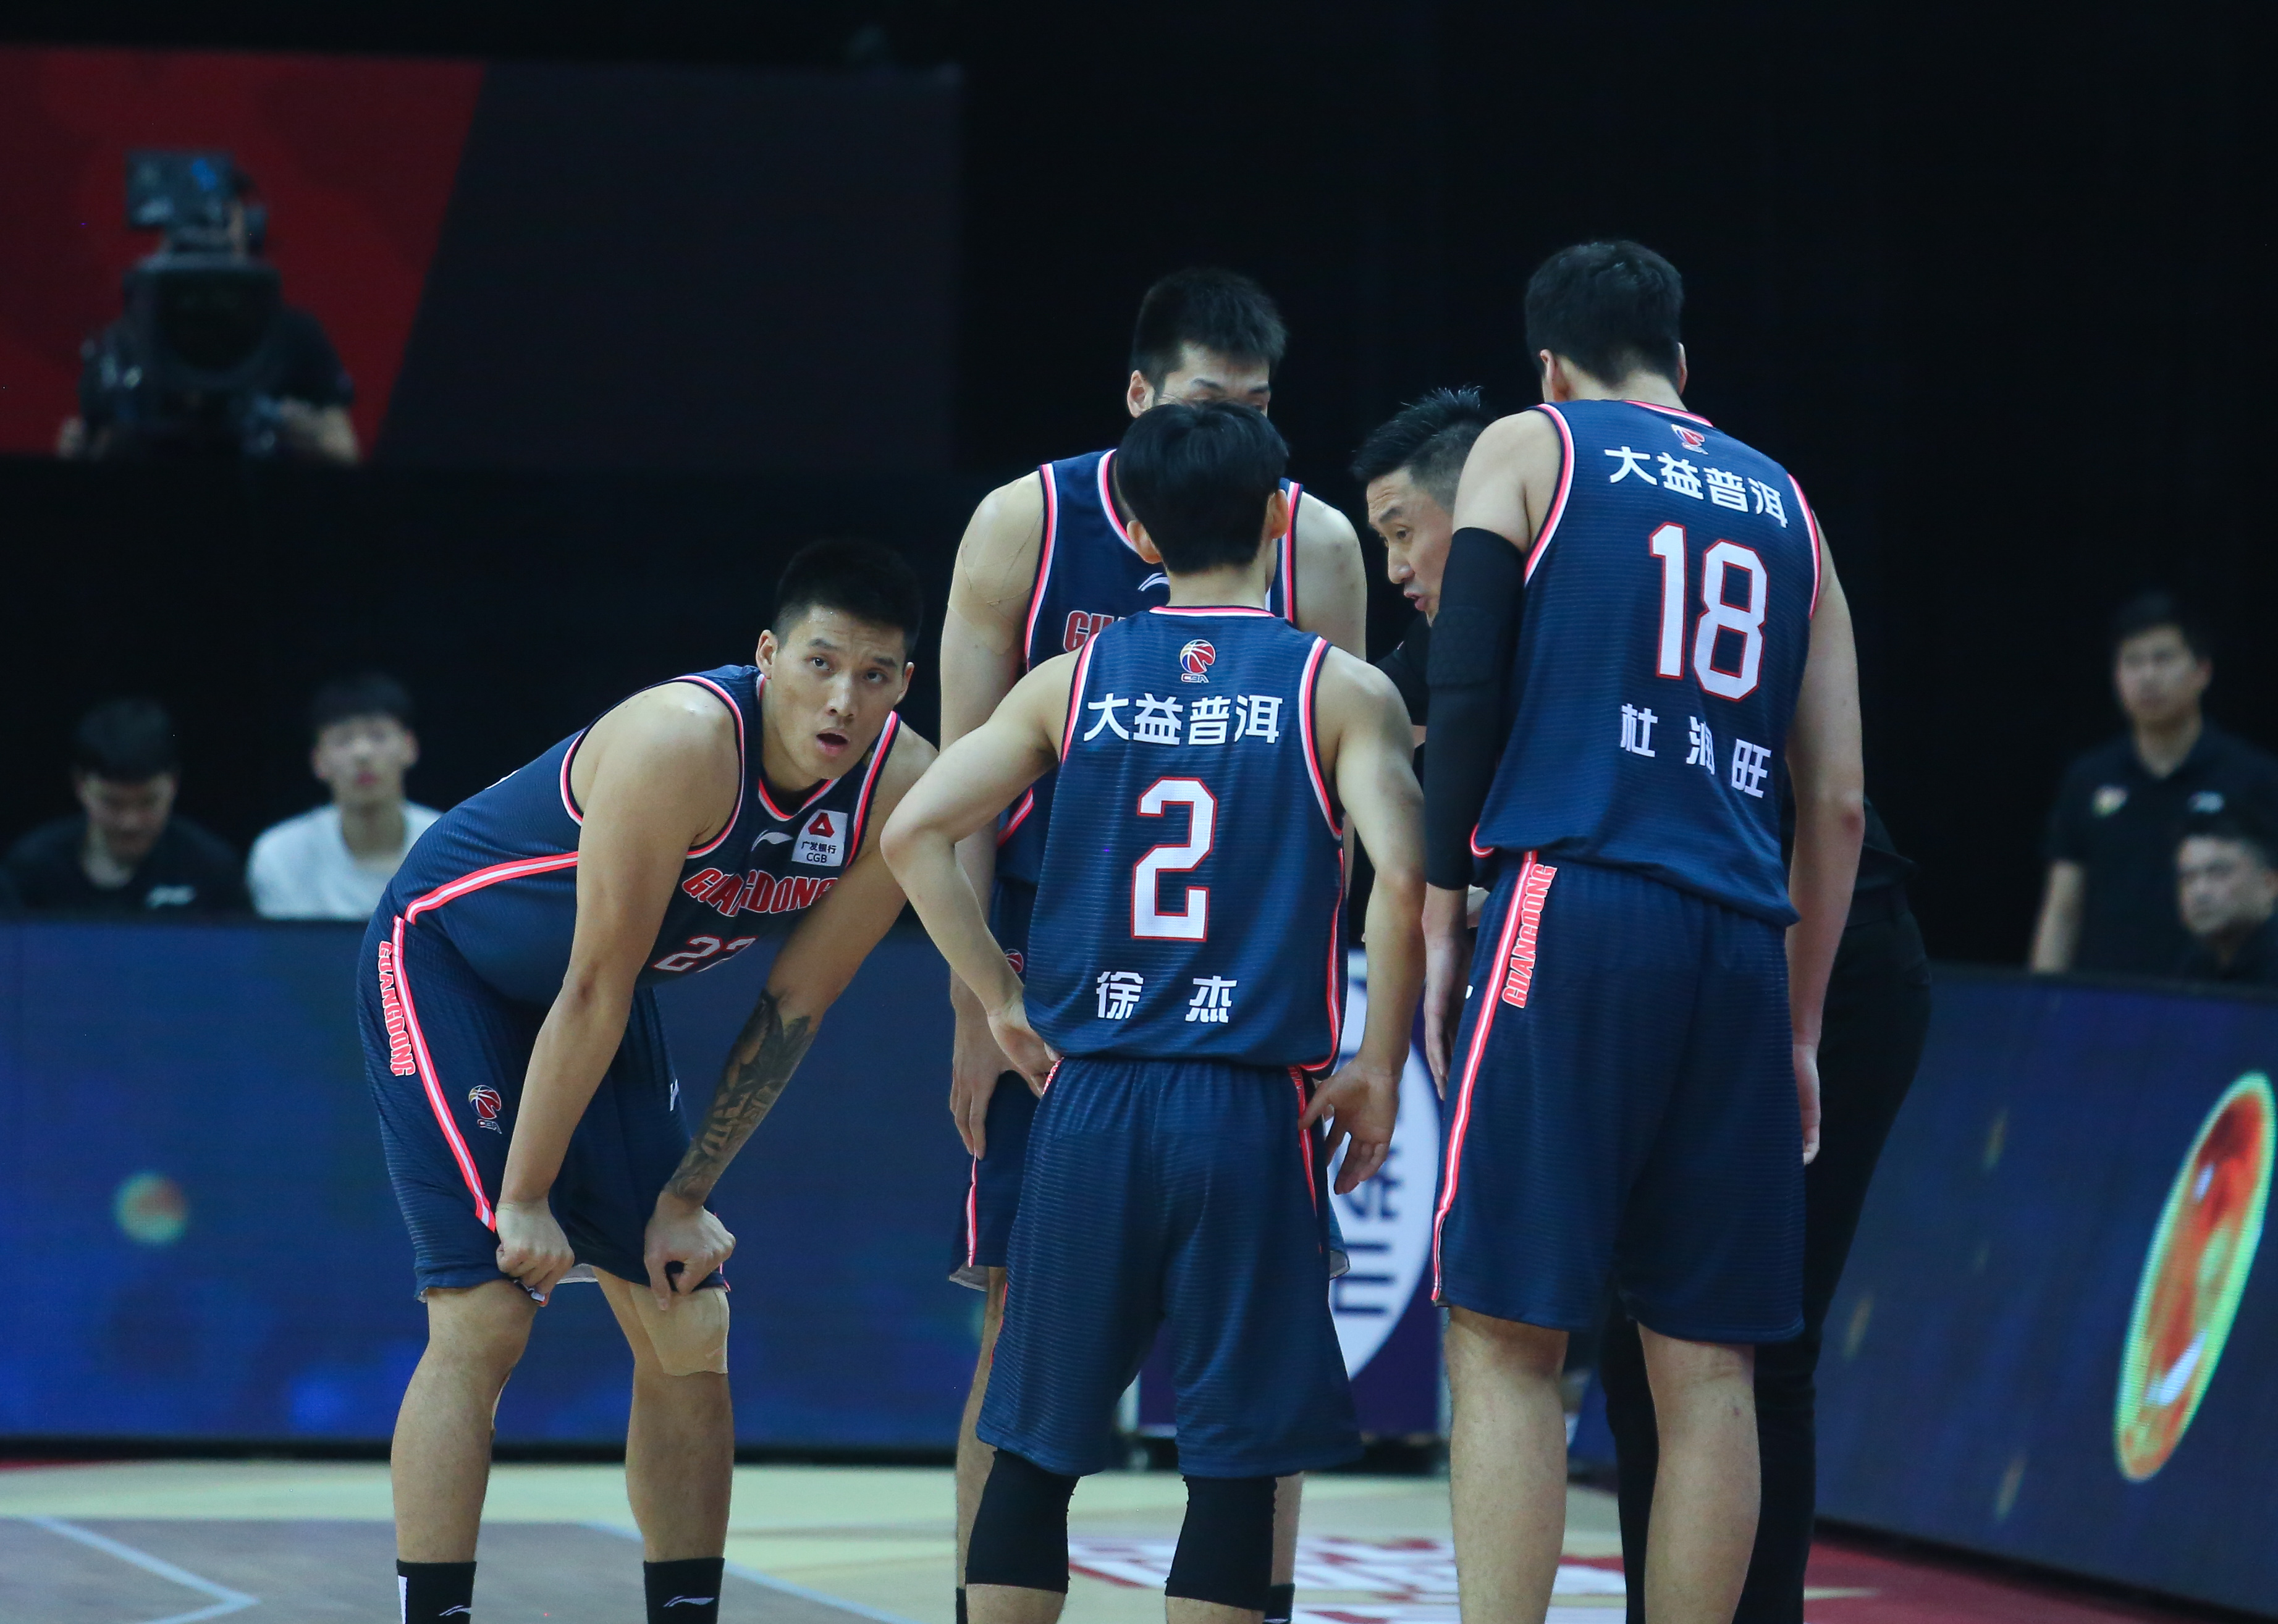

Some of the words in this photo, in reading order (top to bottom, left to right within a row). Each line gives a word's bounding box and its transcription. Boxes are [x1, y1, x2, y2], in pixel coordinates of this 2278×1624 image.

[1605, 446, 1787, 528] 大益普洱
[1649, 522, 1770, 702] 18
[1084, 692, 1283, 745] 大益普洱
[1181, 673, 1209, 683] CBA
[801, 841, 837, 854] 广发银行
[806, 852, 827, 863] CGB
[1131, 776, 1218, 942] 2
[1501, 864, 1558, 1009] GUANGDONG
[378, 940, 416, 1077] GUANGDONG
